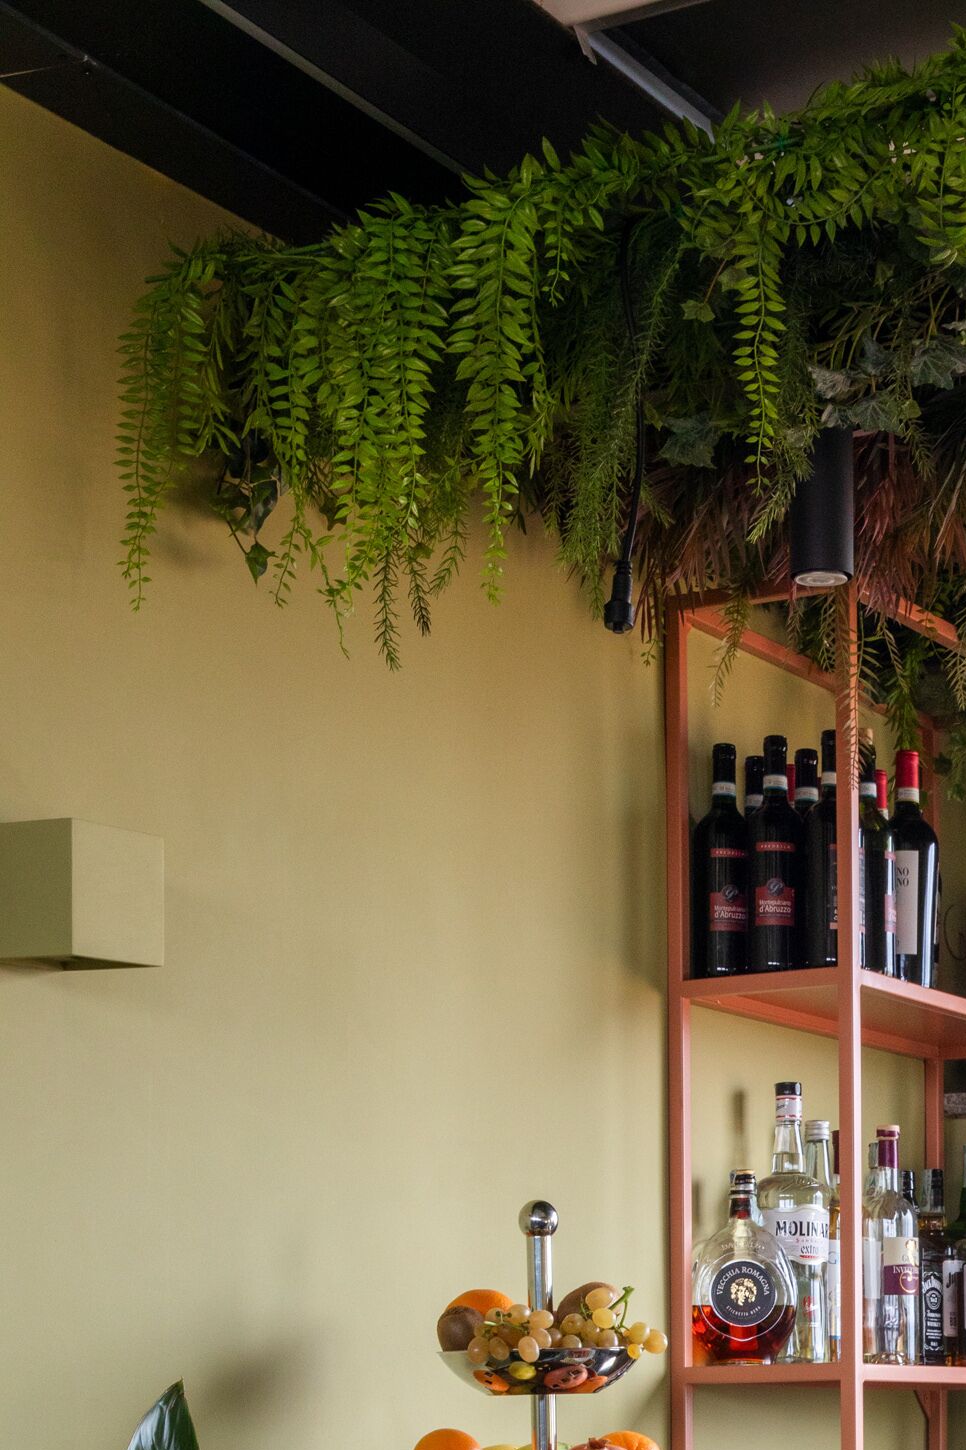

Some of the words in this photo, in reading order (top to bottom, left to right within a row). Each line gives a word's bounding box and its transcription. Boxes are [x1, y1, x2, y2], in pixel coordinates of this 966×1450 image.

[714, 911, 746, 919] d'Abruzzo
[759, 904, 792, 913] d'Abruzzo
[775, 1220, 829, 1238] MOLINAR
[716, 1268, 740, 1295] VECCHIA
[741, 1266, 770, 1296] ROMAGNA
